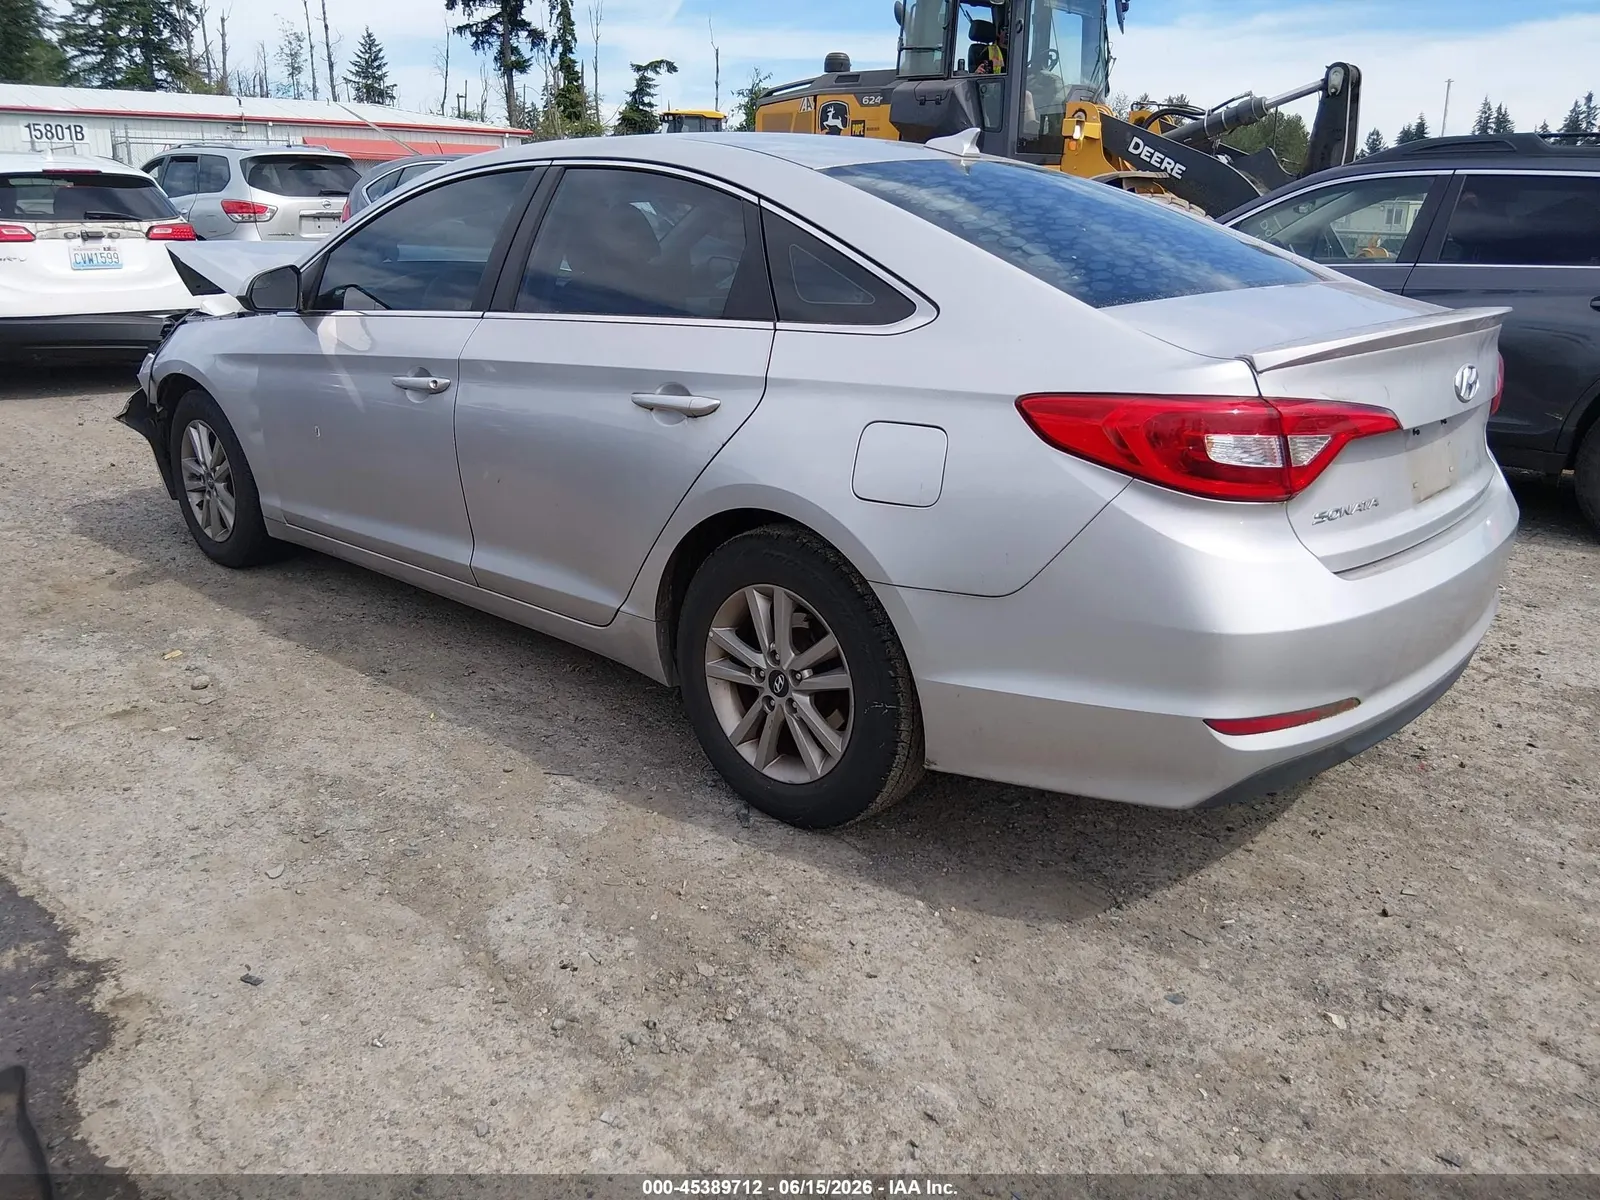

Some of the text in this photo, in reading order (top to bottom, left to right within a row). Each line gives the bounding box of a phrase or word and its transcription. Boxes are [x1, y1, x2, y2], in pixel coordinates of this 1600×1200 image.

[24, 123, 84, 141] 15801B
[1128, 137, 1186, 179] DEERE
[73, 252, 119, 265] CVW1599
[1312, 498, 1379, 525] SONATA
